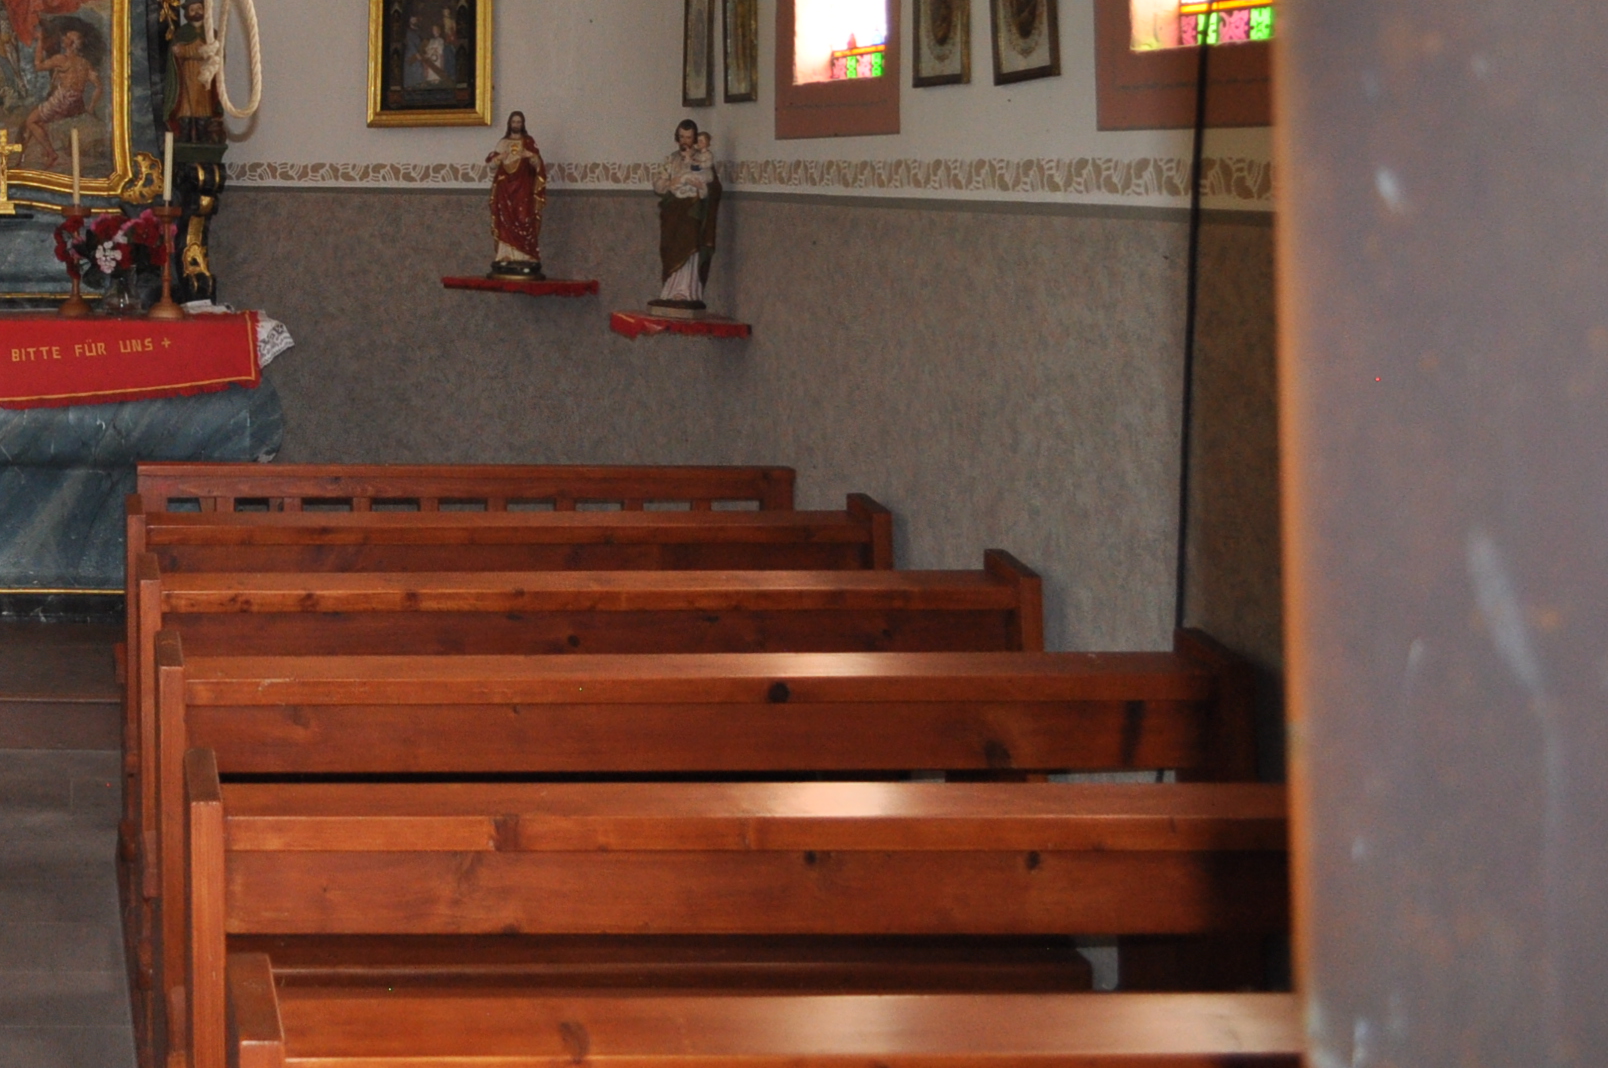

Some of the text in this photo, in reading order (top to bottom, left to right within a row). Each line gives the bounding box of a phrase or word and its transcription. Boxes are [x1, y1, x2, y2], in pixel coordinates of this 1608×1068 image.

[11, 346, 61, 362] BITTE
[74, 339, 107, 357] FÜR
[119, 337, 154, 353] UNS
